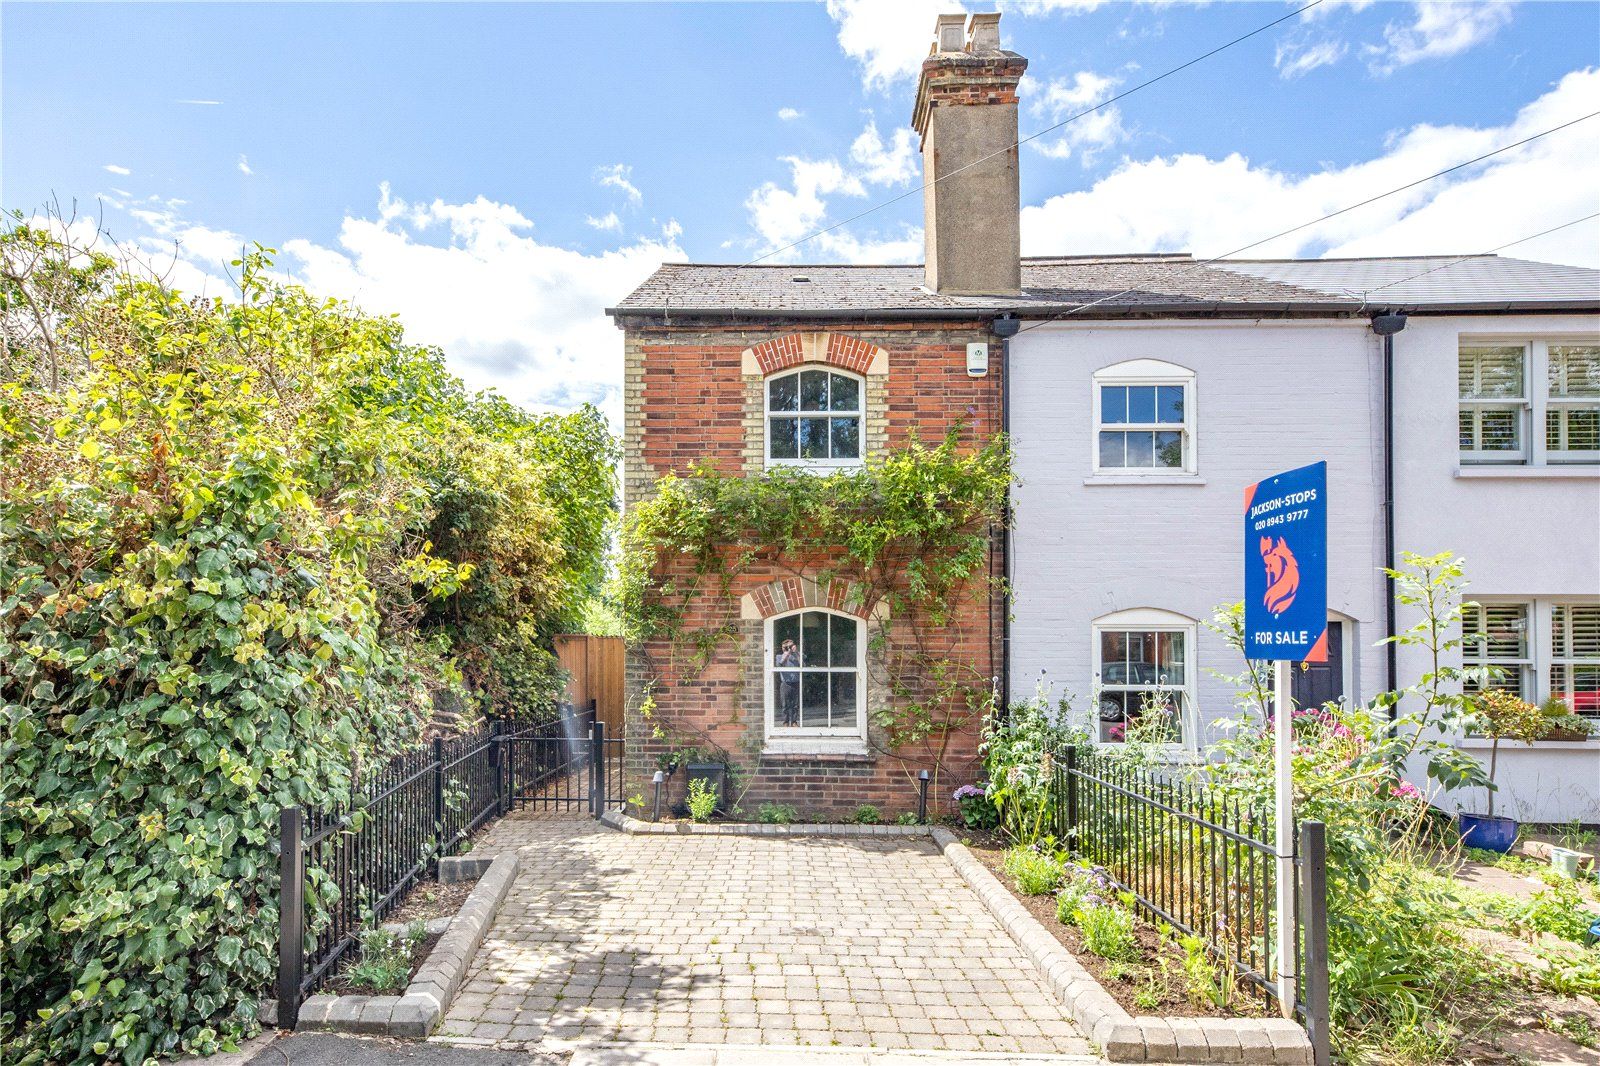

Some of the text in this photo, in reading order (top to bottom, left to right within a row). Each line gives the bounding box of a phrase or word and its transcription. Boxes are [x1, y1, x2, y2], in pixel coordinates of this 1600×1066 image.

[1251, 489, 1317, 519] JACKSON-STOPS
[1254, 509, 1309, 530] 020 8943 9777
[1255, 631, 1308, 645] FOR SALE
